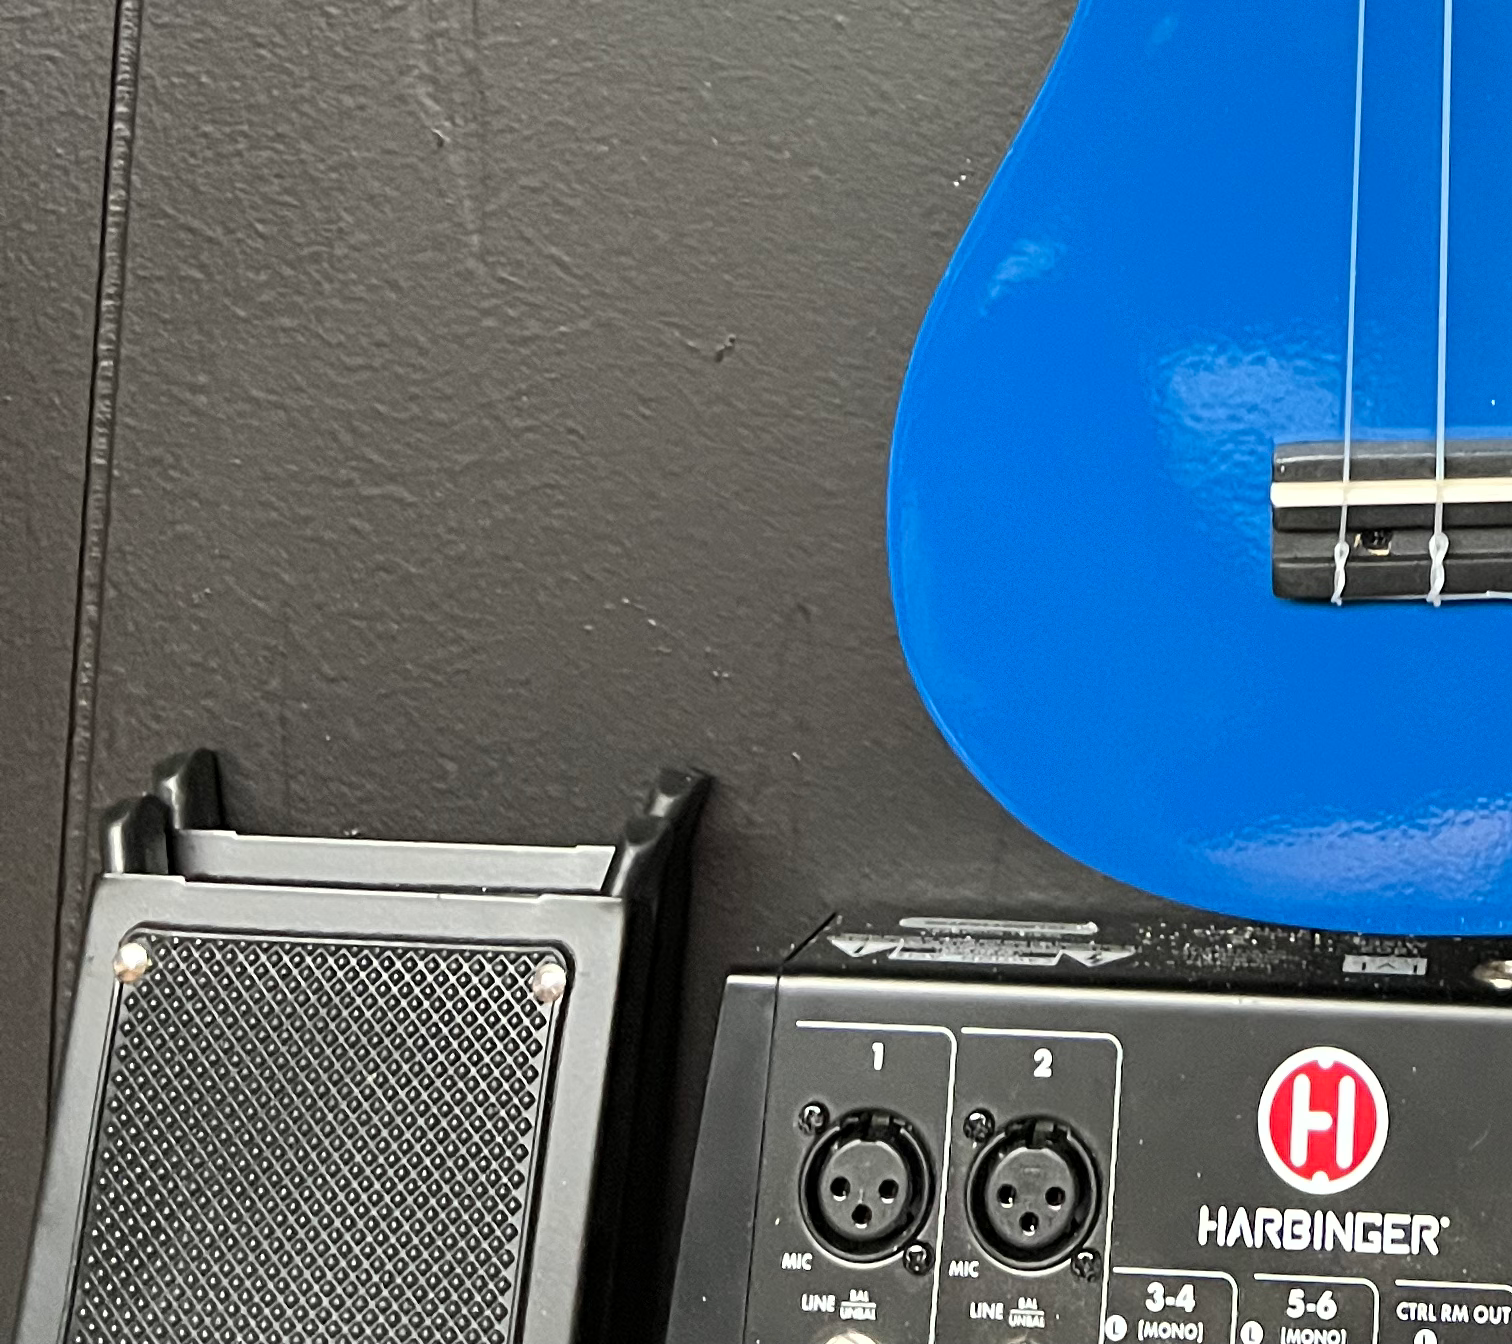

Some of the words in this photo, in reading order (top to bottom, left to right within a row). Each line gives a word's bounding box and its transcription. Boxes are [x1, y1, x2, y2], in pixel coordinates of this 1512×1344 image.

[872, 1043, 884, 1070] 1
[1033, 1048, 1053, 1078] 2
[1290, 1074, 1356, 1169] H
[1198, 1205, 1440, 1255] HARBINGER
[781, 1252, 812, 1271] MIC
[949, 1260, 980, 1278] MIC
[801, 1294, 836, 1313] LINE
[969, 1302, 1004, 1320] LINE
[1145, 1282, 1196, 1313] 3-4
[1286, 1288, 1338, 1320] 5-6
[1396, 1302, 1437, 1323] CTRL
[1441, 1304, 1469, 1325] RM
[1473, 1306, 1512, 1325] OUT
